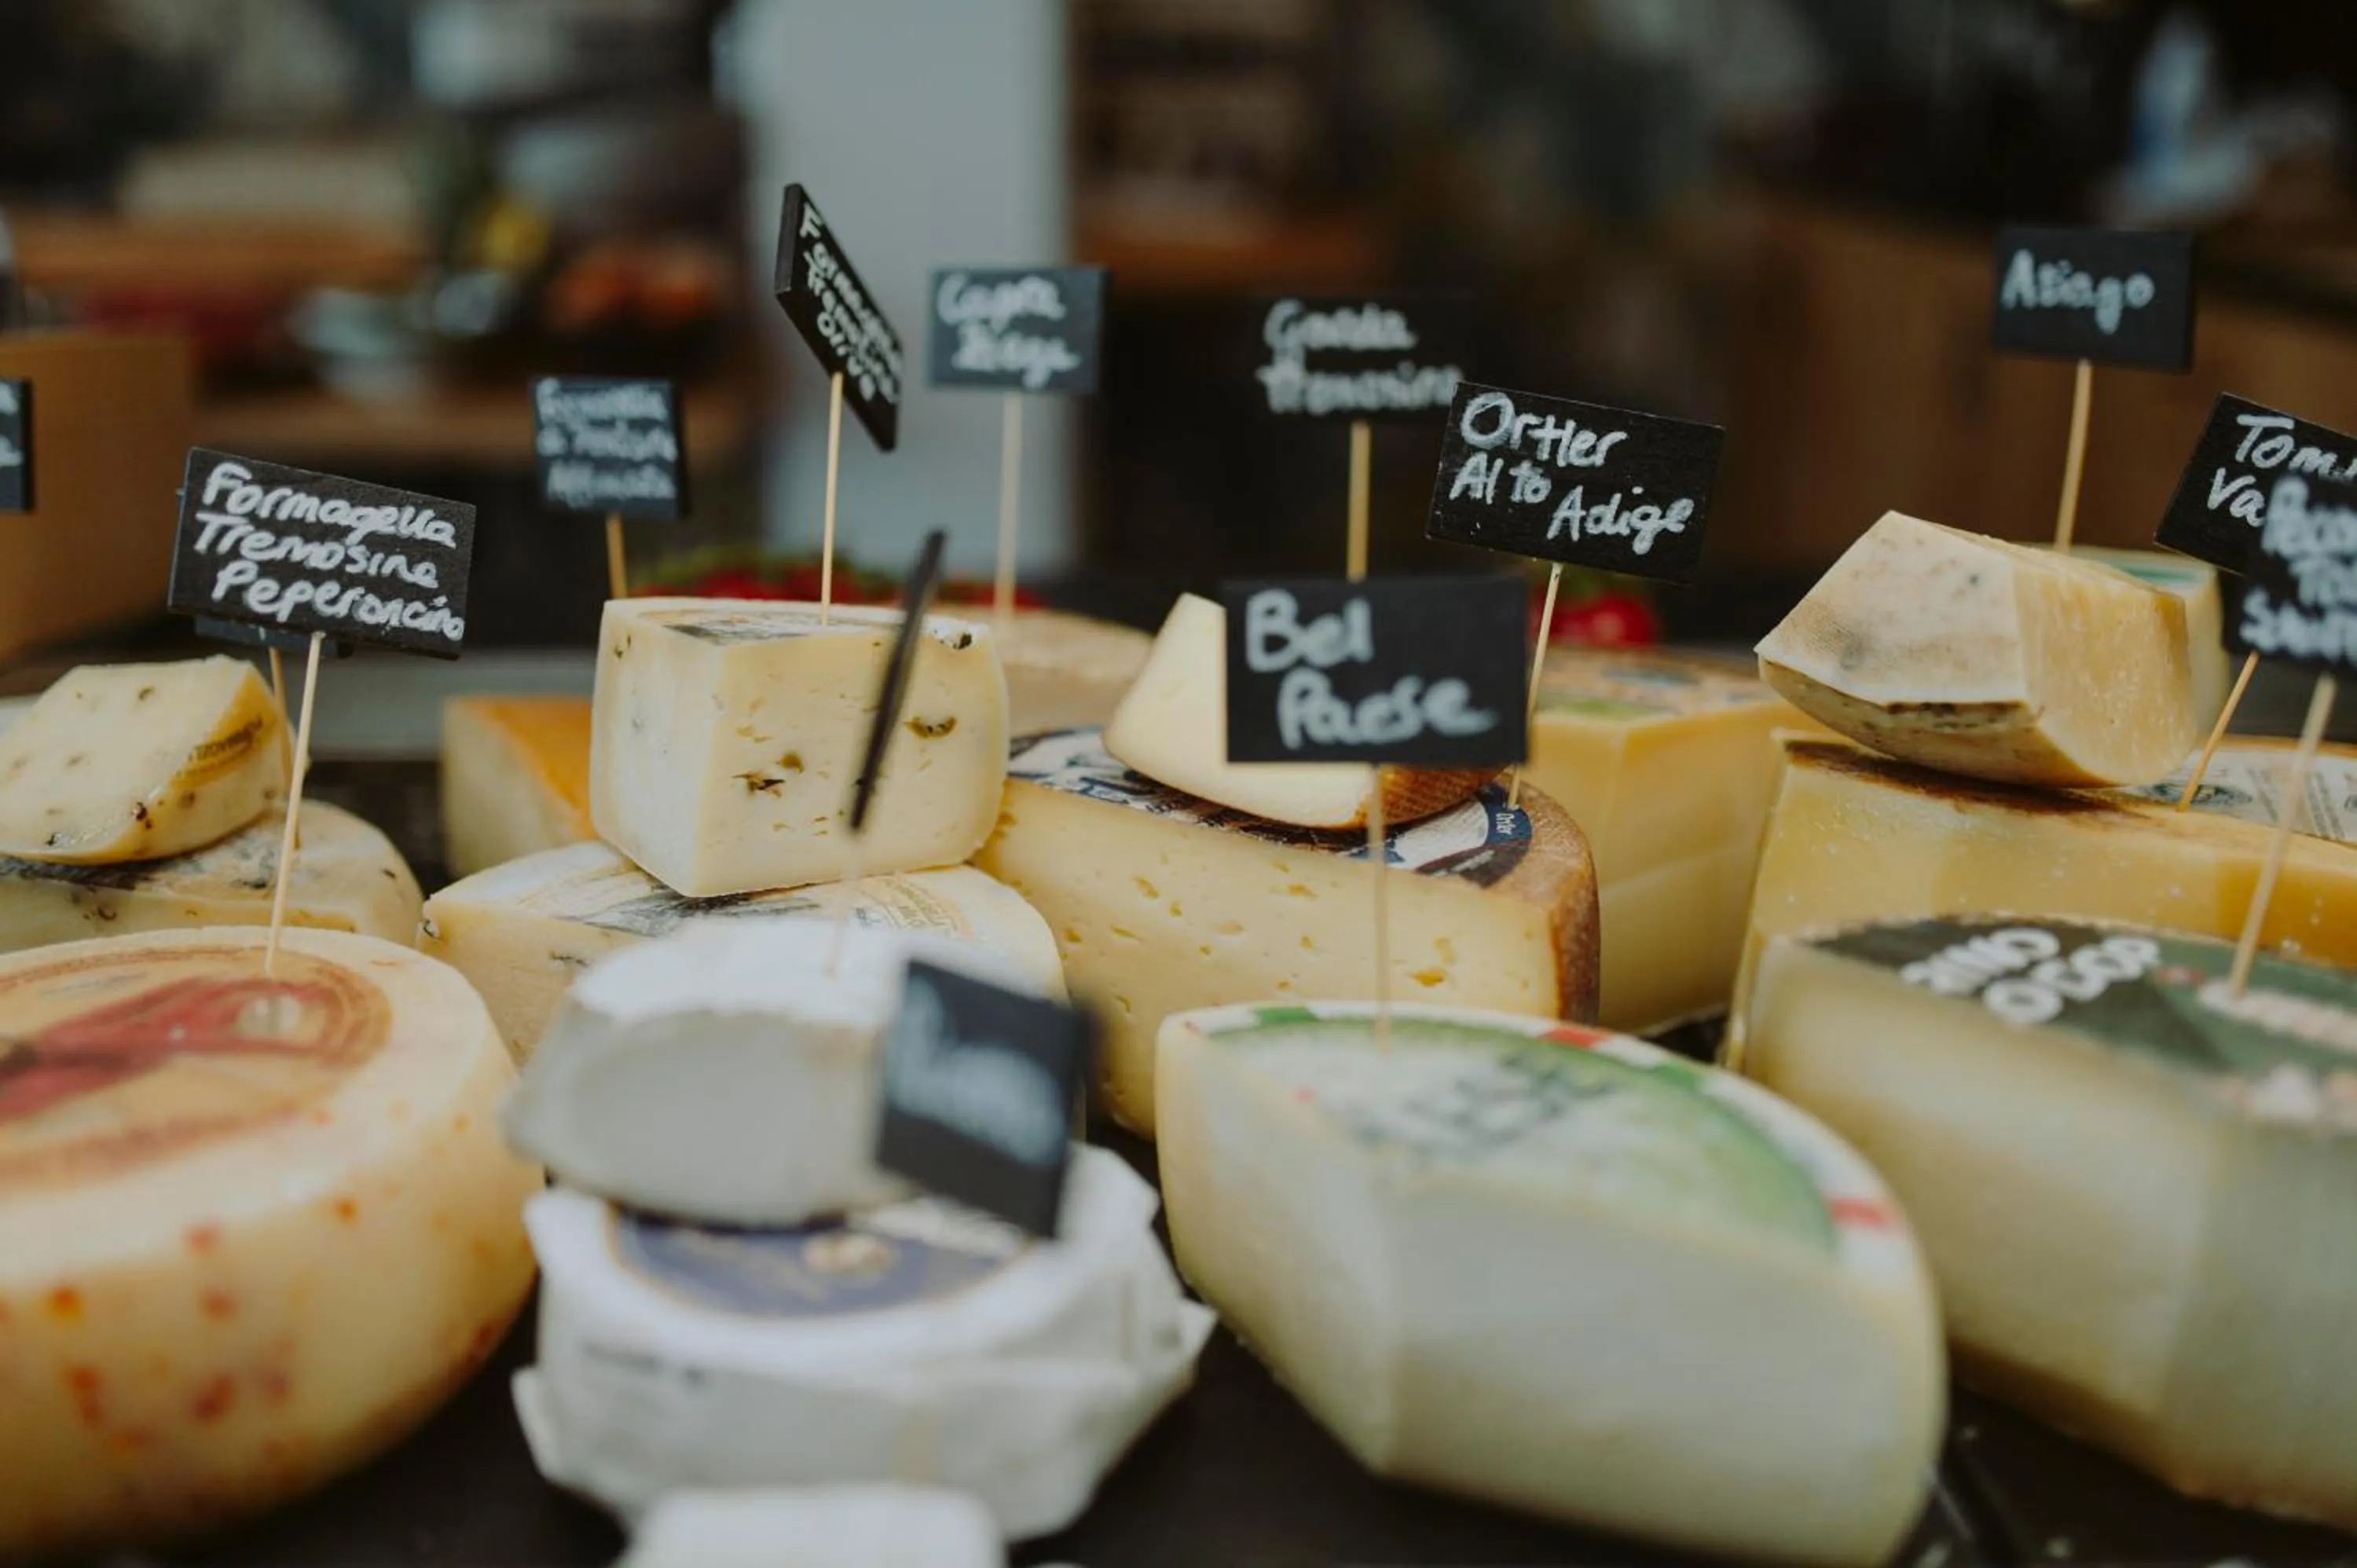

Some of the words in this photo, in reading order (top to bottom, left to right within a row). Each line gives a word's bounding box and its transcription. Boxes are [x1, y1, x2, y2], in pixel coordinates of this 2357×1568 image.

[1460, 391, 1628, 468] Ortler
[2234, 414, 2357, 481] Tom
[201, 461, 457, 549] Formagella
[1546, 484, 1695, 555] Adige
[1245, 588, 1375, 673] Bel
